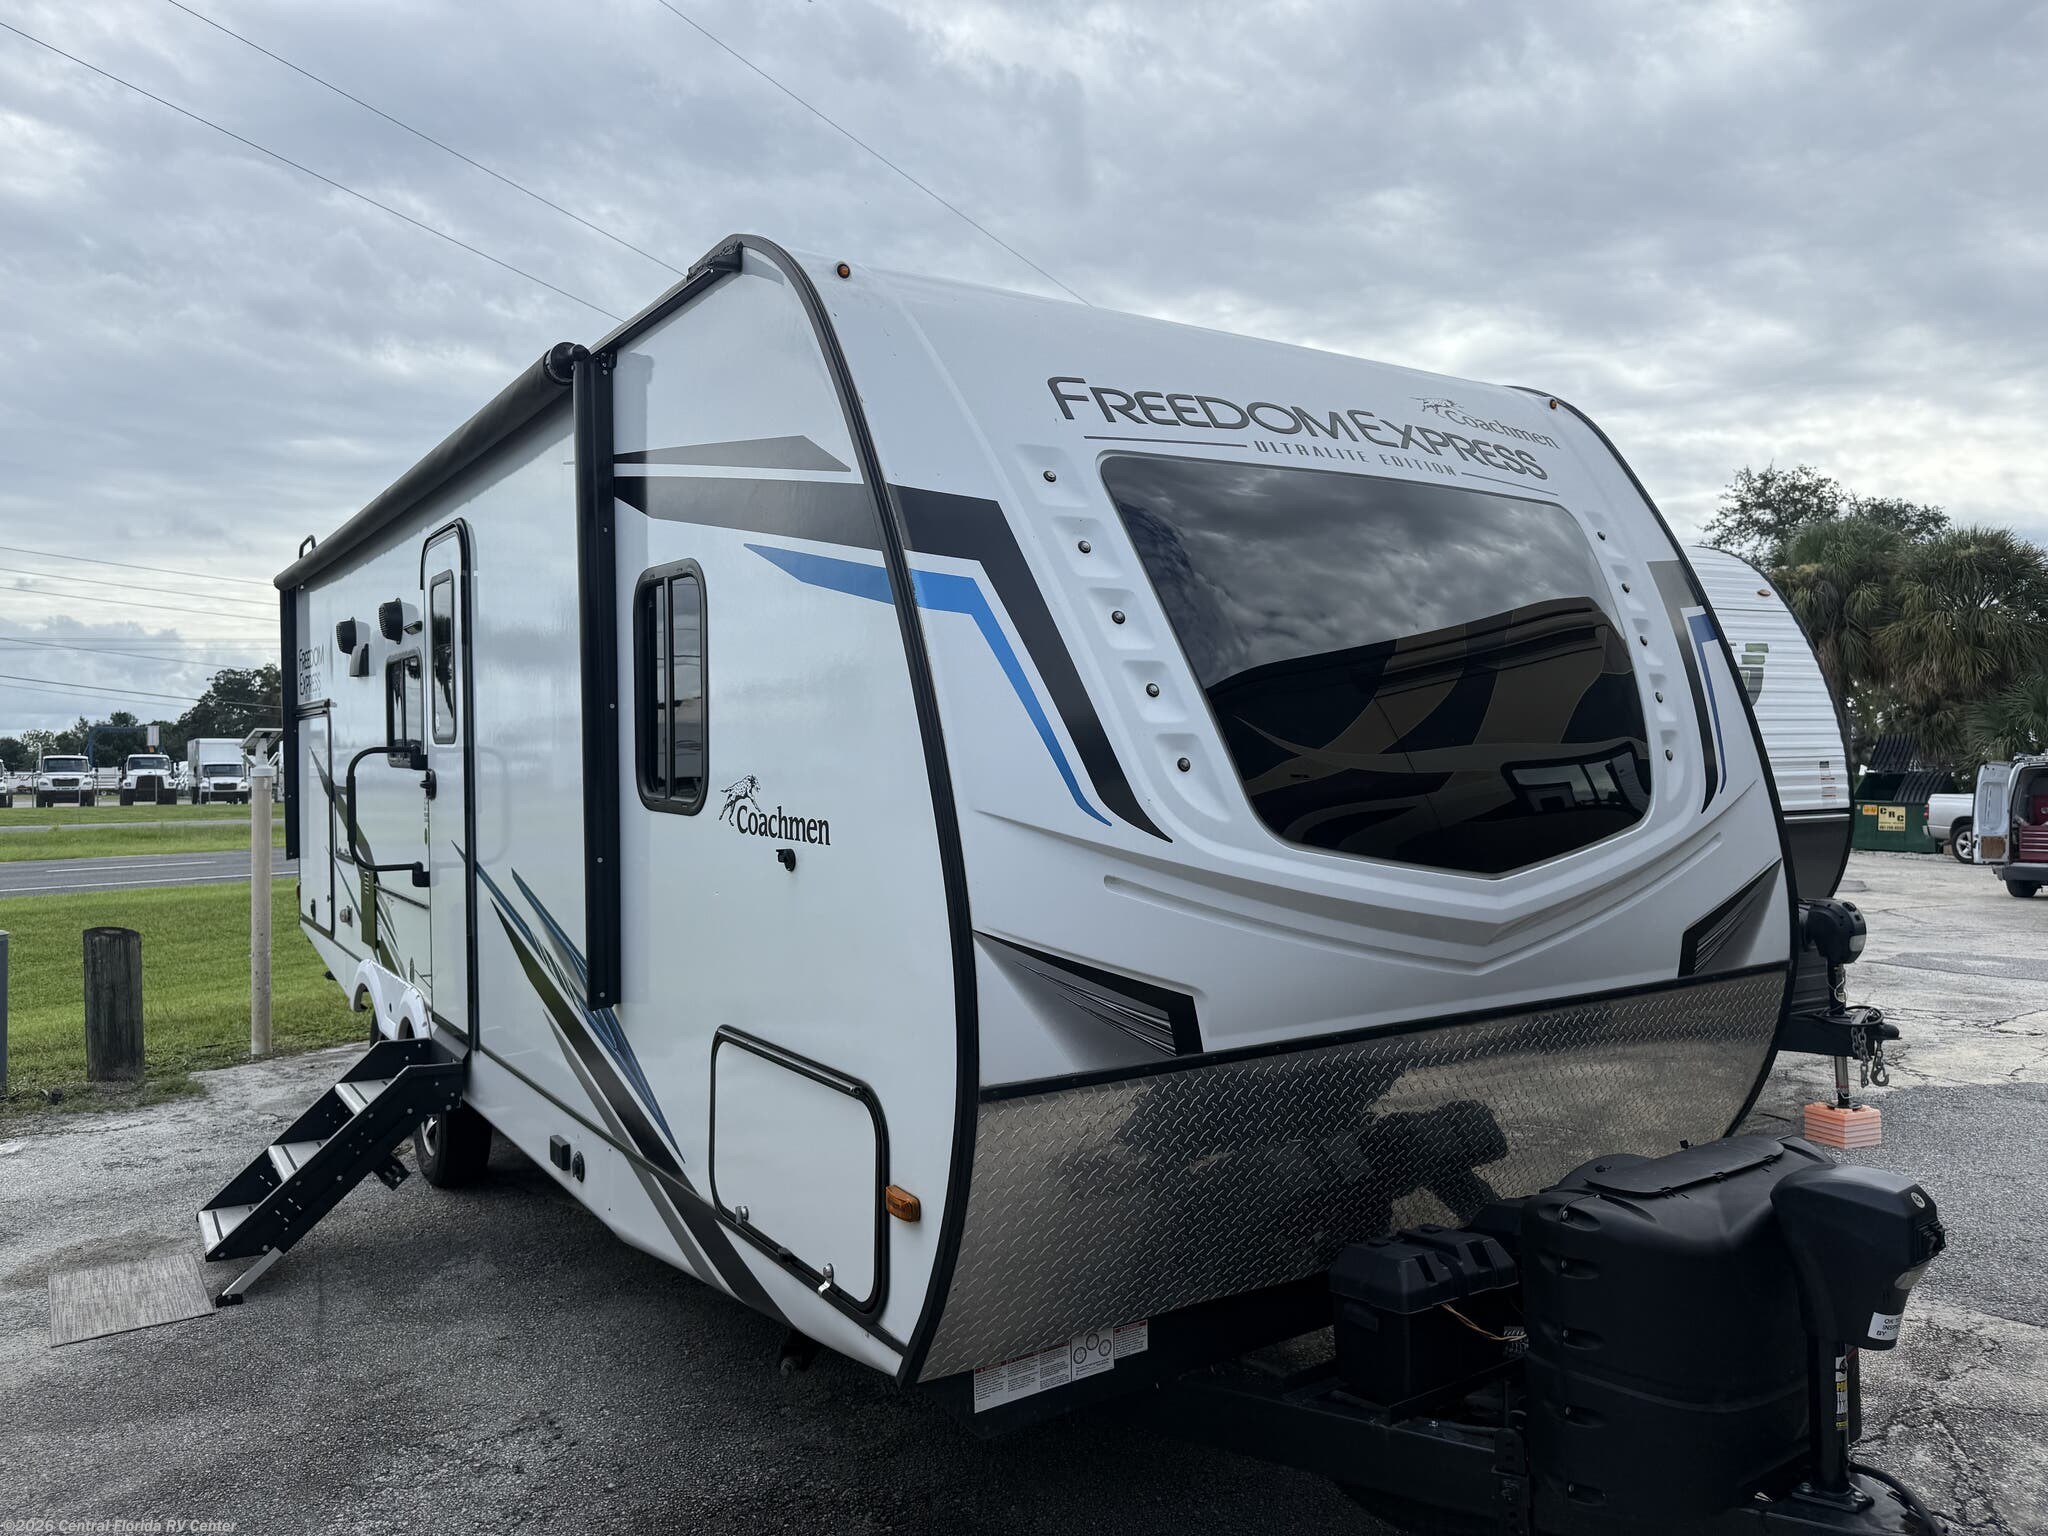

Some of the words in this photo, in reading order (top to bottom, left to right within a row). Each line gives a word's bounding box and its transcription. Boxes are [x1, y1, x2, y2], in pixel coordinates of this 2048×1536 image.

[1444, 409, 1561, 449] Coachmen
[1253, 440, 1370, 463] ULTRALITE
[1380, 453, 1457, 476] EDITION
[299, 643, 325, 672] FREEDOM
[300, 671, 321, 695] EXPRESS
[736, 804, 831, 846] Coachmen
